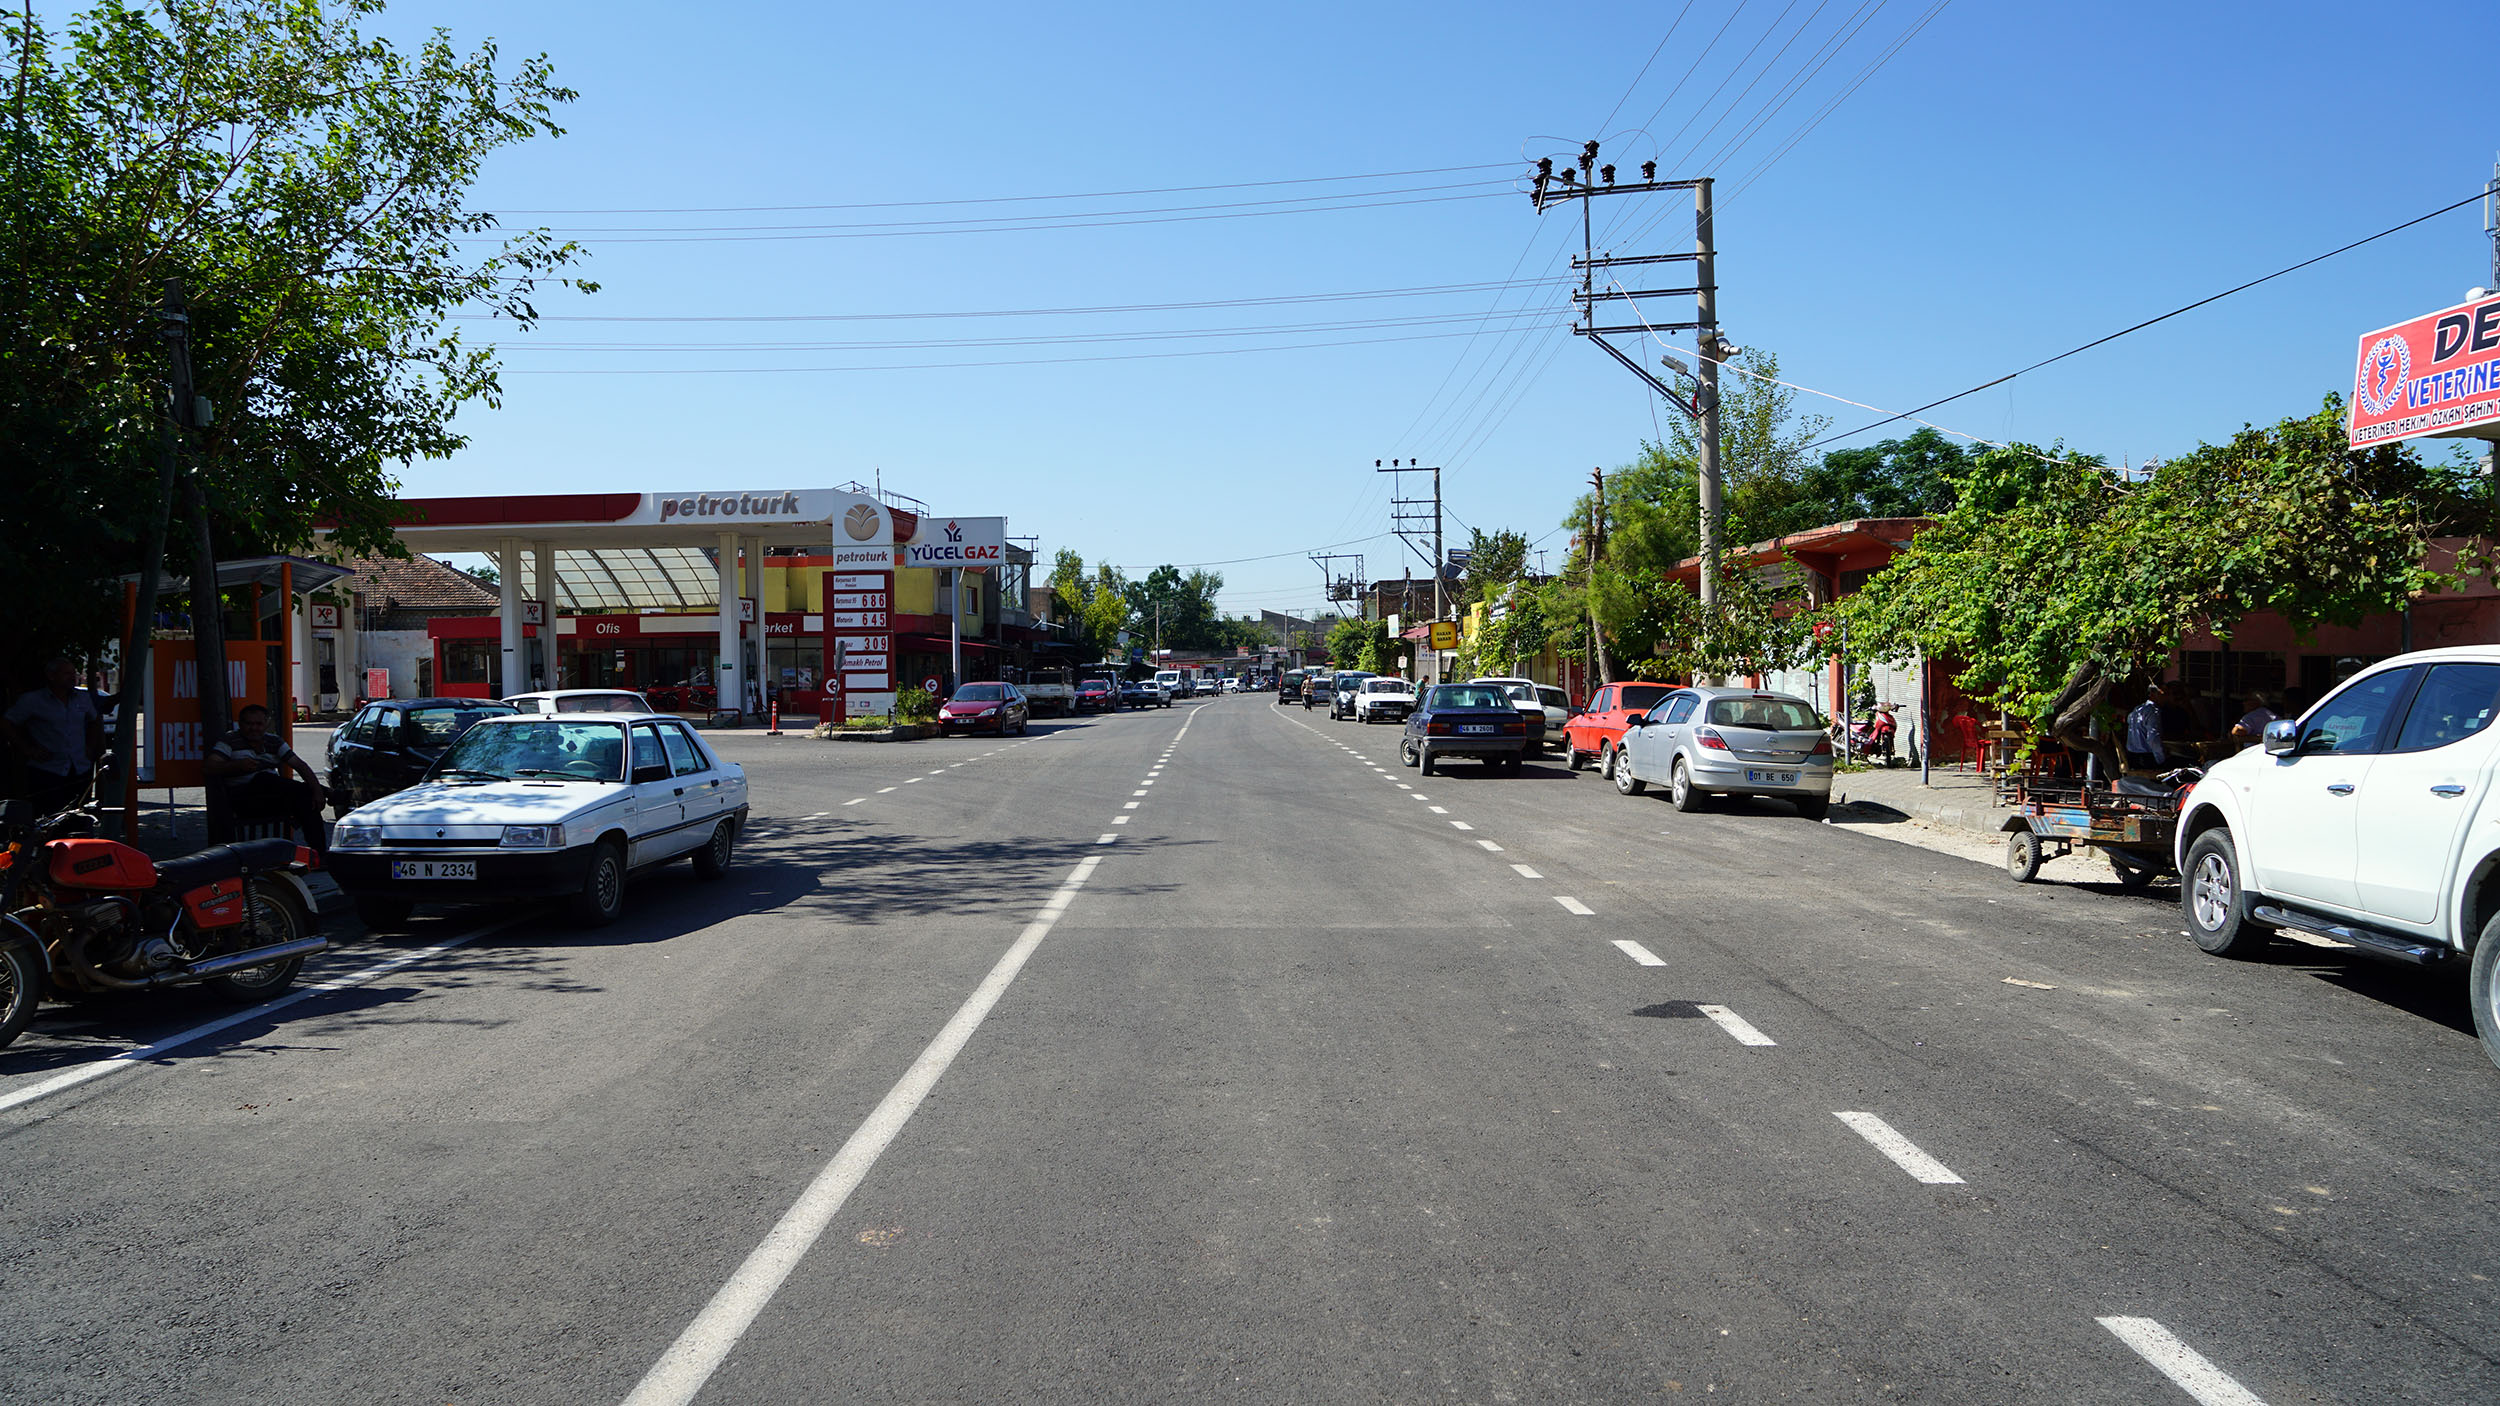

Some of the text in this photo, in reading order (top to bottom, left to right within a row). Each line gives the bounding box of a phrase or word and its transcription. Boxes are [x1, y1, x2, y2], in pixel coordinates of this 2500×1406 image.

[2431, 409, 2462, 426] ÖZKAN
[660, 491, 799, 522] petroturk
[836, 551, 888, 565] petroturk
[595, 623, 620, 634] Ofis
[765, 622, 793, 633] arket
[1753, 772, 1795, 782] 01 BE 650
[400, 863, 474, 877] 46 N 2334
